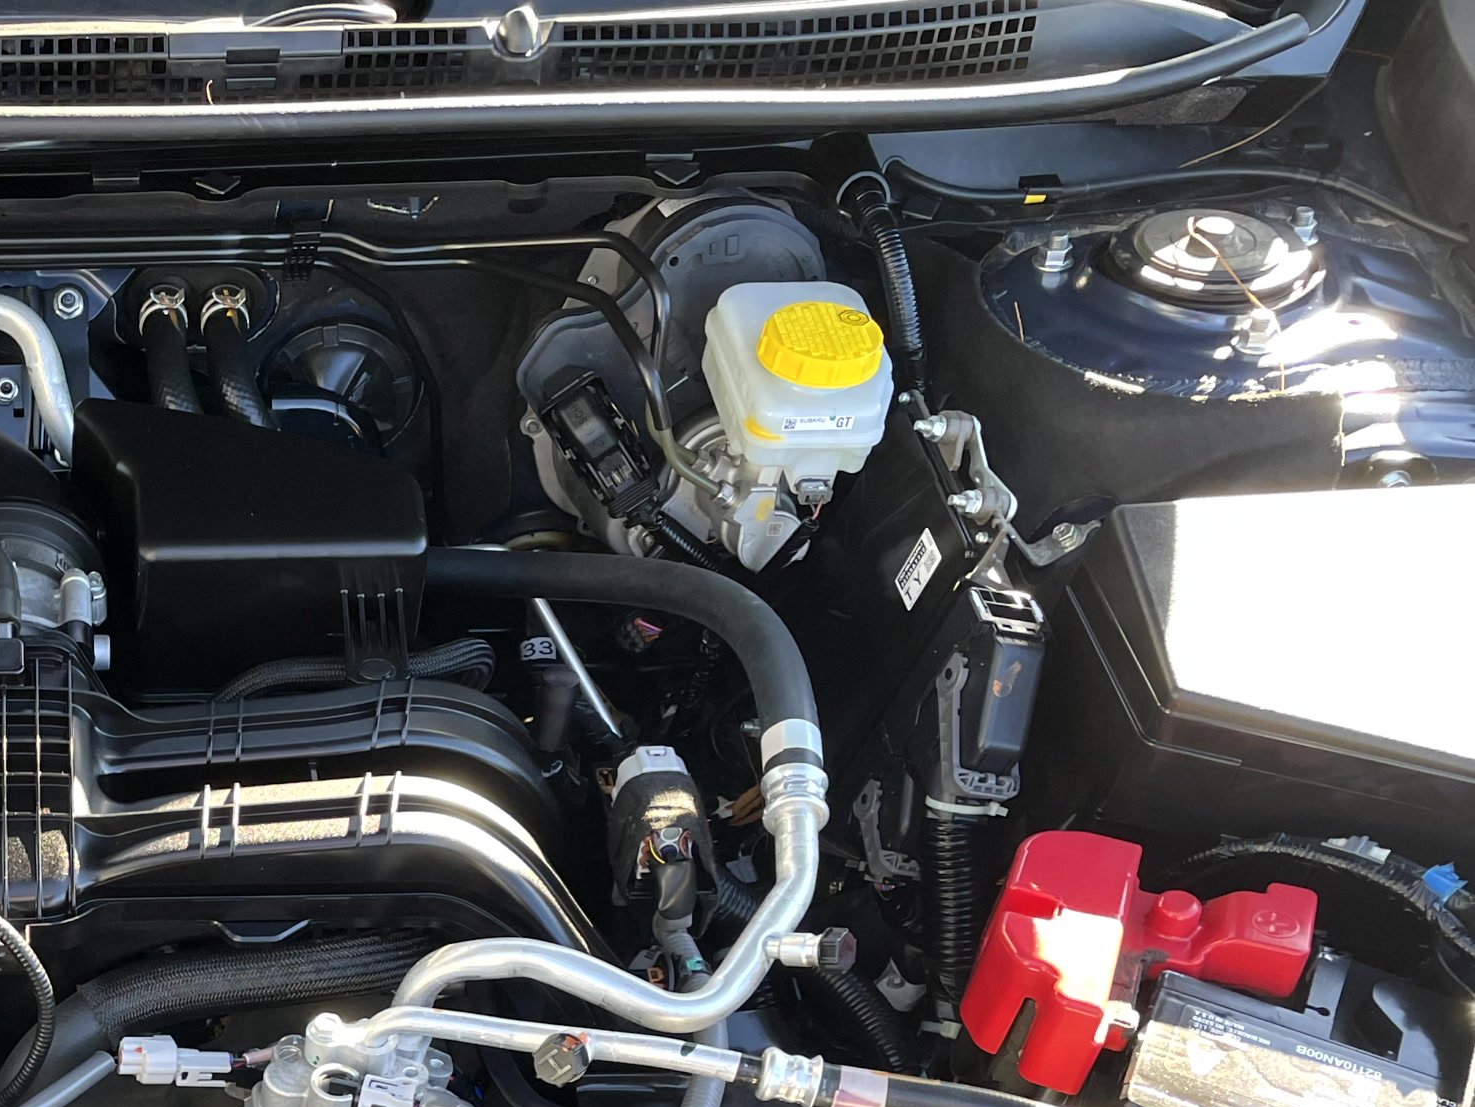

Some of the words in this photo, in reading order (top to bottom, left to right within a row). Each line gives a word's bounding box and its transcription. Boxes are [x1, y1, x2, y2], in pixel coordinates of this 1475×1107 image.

[836, 417, 852, 428] GT
[524, 640, 553, 658] 33
[538, 1048, 572, 1081] H
